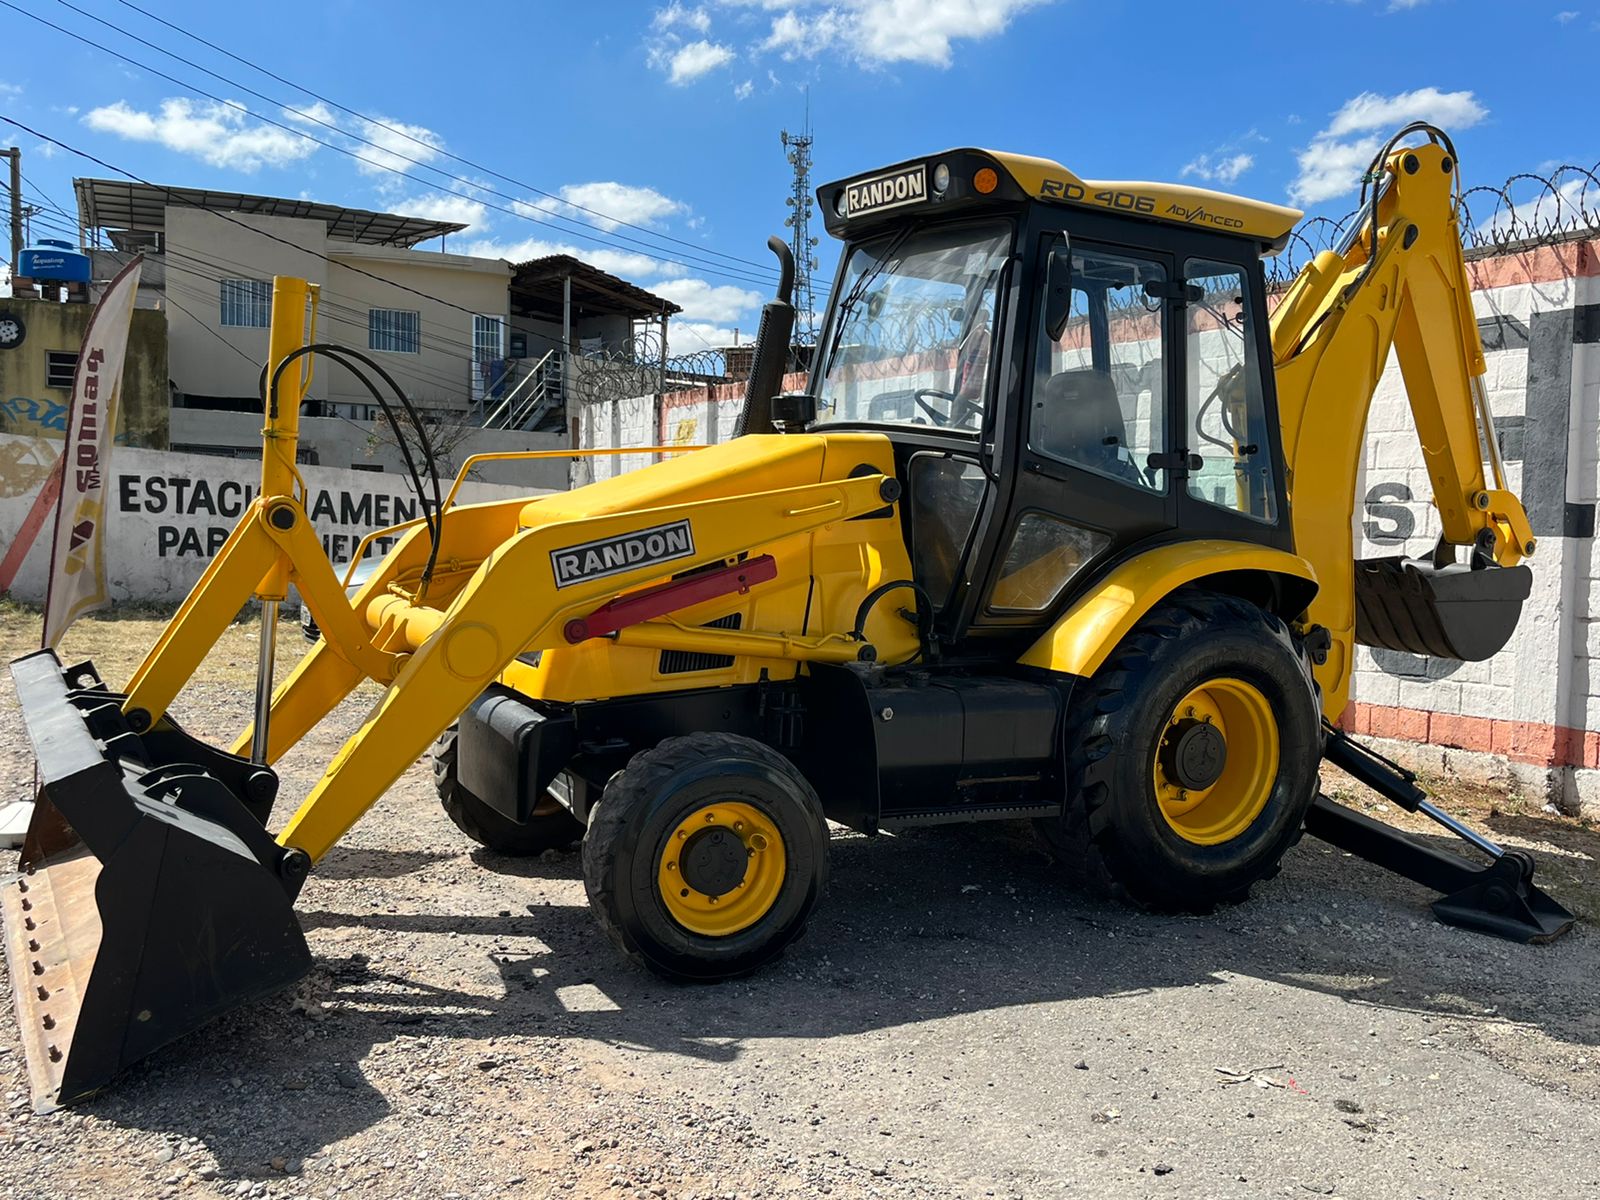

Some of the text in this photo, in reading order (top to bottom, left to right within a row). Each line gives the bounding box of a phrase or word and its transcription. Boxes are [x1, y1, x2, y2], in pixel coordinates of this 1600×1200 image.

[849, 173, 922, 211] RANDON
[1040, 179, 1085, 200] RD
[1095, 191, 1155, 213] 406
[558, 528, 688, 579] RANDON
